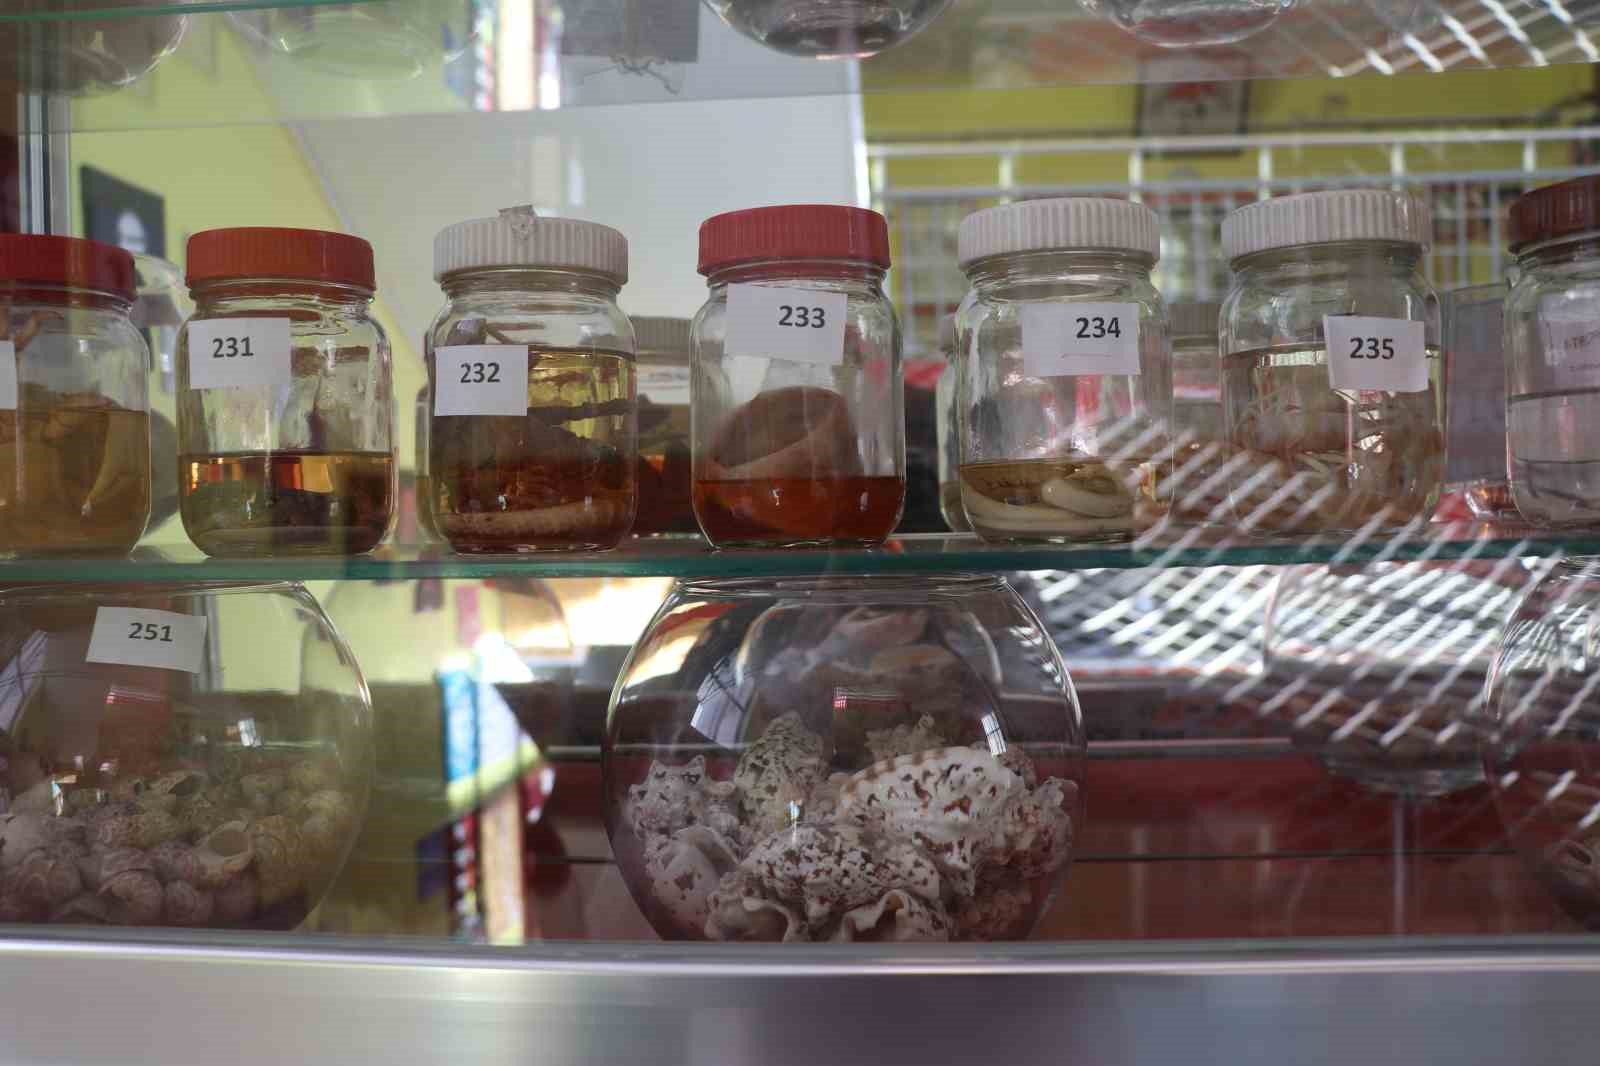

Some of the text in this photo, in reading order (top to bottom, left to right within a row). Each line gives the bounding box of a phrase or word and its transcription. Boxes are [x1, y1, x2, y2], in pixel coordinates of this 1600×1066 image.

[778, 305, 825, 329] 233
[1076, 316, 1121, 339] 234
[212, 336, 254, 359] 231
[1350, 337, 1394, 360] 235
[460, 362, 500, 384] 232
[128, 622, 173, 642] 251
